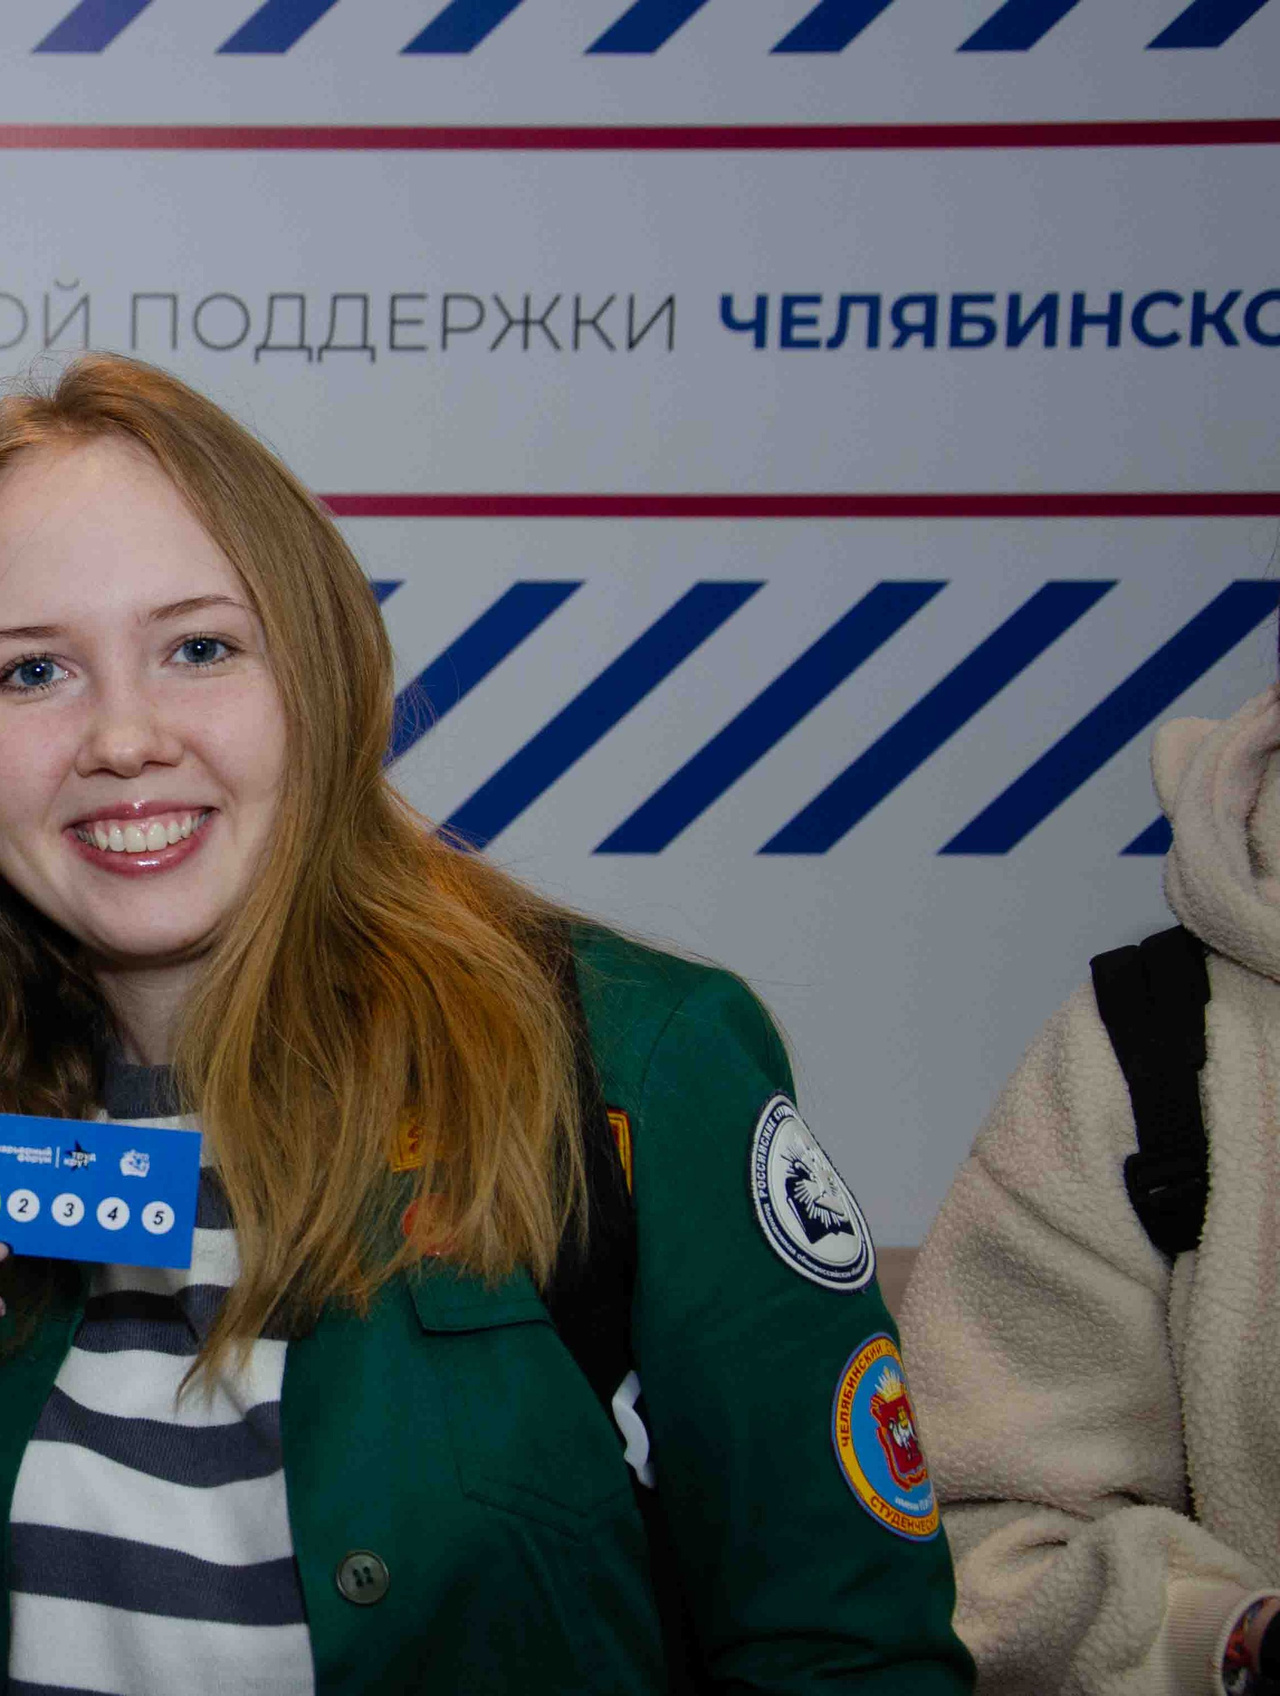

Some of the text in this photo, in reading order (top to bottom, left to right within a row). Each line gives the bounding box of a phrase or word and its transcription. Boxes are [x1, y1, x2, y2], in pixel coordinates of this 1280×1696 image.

[130, 292, 676, 364] ПОДДЕРЖКИ
[719, 289, 1280, 351] ЧЕЛЯБИНСКО
[17, 1198, 166, 1226] 2 3 4 5
